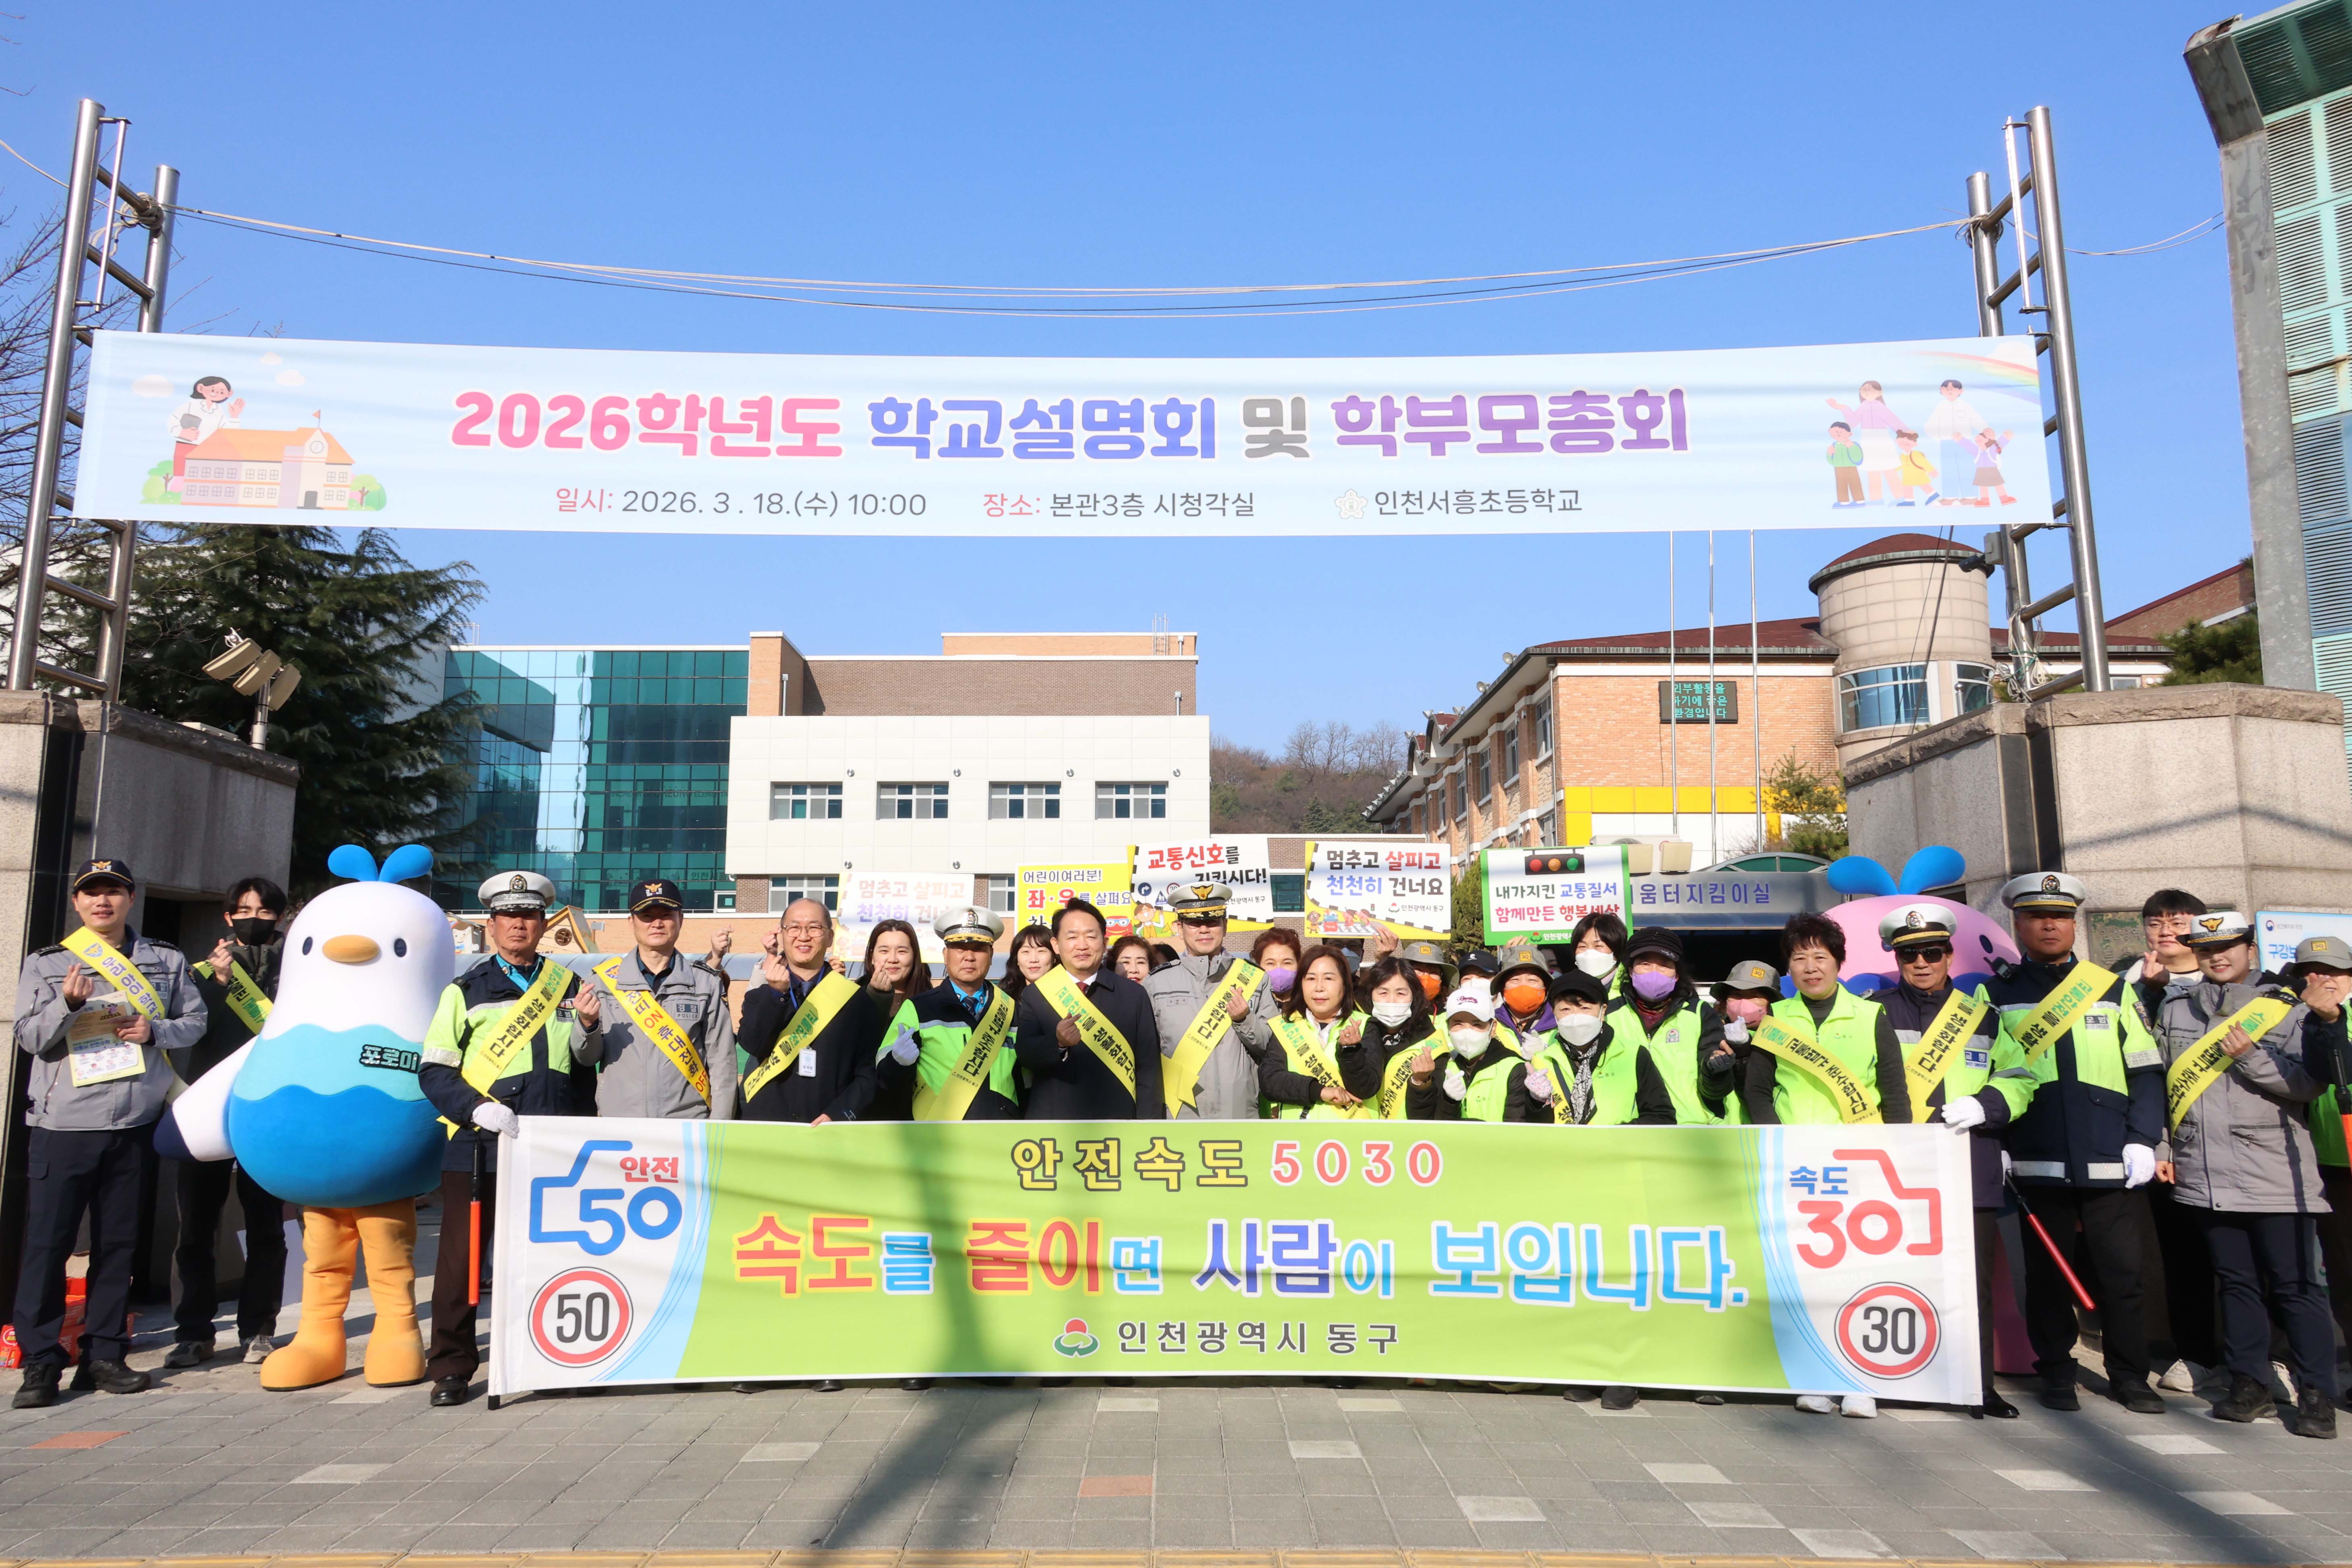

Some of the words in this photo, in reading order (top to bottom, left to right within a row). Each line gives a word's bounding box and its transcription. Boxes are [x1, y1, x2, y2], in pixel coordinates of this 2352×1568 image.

[452, 392, 842, 458] 2026학년도
[868, 397, 1215, 460] 학교설명회
[1242, 398, 1310, 458] 및
[1331, 388, 1688, 456] 학부모총회
[556, 489, 613, 514] 일시:
[622, 490, 705, 515] 2026.
[755, 492, 839, 517] 18.(수)
[848, 494, 926, 517] 10:00
[984, 493, 1042, 517] 장소:
[1050, 493, 1145, 517] 본관3층
[1154, 493, 1254, 518] 시청각실
[1375, 490, 1582, 516] 인천서흥초등학교
[1148, 844, 1239, 871] 교통신호를
[1327, 850, 1379, 870] 멈추고
[1385, 851, 1441, 871] 살피고
[860, 880, 908, 898] 멈추고
[914, 881, 964, 900] 살피고
[1024, 870, 1102, 883] 어린이여러분!
[1327, 875, 1381, 895] 천천히
[1389, 878, 1443, 896] 건너요
[1496, 884, 1555, 899] 내가지킨
[1560, 882, 1617, 899] 교통질서
[1096, 892, 1131, 905] 살펴요
[1630, 883, 1770, 904] 움터지킴이실
[857, 904, 908, 922] 천천히
[1496, 906, 1555, 922] 함께만든
[102, 956, 123, 976] 우리
[122, 973, 144, 995] 아이
[139, 989, 158, 1015] 학교
[678, 1004, 698, 1013] 경찰
[2042, 979, 2092, 1027] 교통안전을
[490, 998, 545, 1058] 생활화합시다
[623, 990, 650, 1015] 전띠
[644, 1009, 664, 1029] ON
[657, 1024, 699, 1078] 휴대전화
[1918, 1013, 1968, 1073] 생활화합시다
[361, 1045, 418, 1071] 포로미
[963, 1032, 995, 1077] 준수합시다
[1762, 1025, 1789, 1046] 스쿨존
[1786, 1038, 1828, 1068] 교통법규
[1826, 1065, 1868, 1115] 준수합시다
[620, 1157, 679, 1183] 안전
[1012, 1137, 1248, 1192] 안전속도
[1270, 1140, 1442, 1187] 5030
[1789, 1166, 1848, 1195] 속도
[577, 1186, 683, 1255] 50
[1796, 1200, 1903, 1269] 30
[733, 1211, 936, 1298] 속도를
[963, 1216, 1162, 1296] 줄이면
[1193, 1218, 1395, 1299] 사람이
[1430, 1220, 1749, 1313] 보입니다.
[557, 1293, 609, 1343] 50
[1861, 1307, 1916, 1354] 30
[1118, 1321, 1306, 1354] 인천광역시
[1327, 1323, 1399, 1355] 동구
